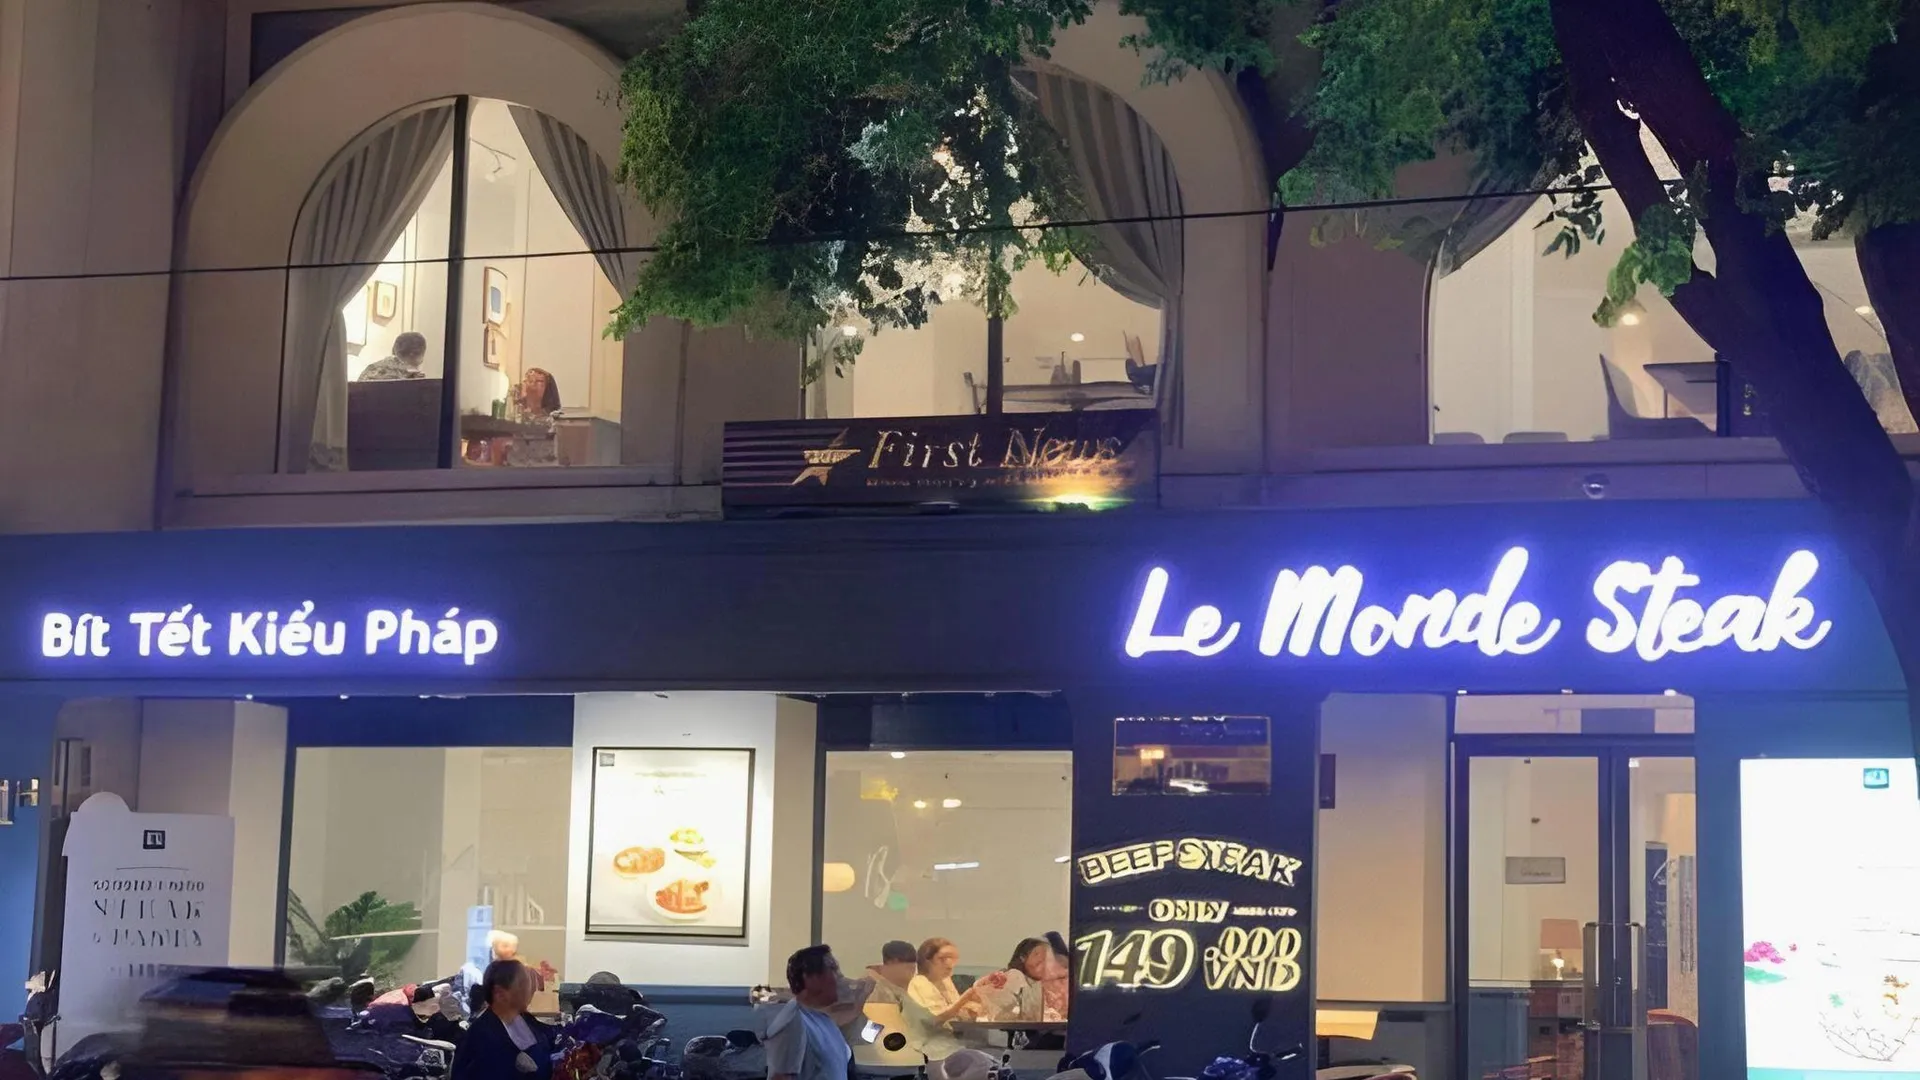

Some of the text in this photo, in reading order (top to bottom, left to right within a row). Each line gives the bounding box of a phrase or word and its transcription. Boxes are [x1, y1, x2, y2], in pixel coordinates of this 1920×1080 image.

[867, 430, 983, 469] First
[1125, 546, 1832, 661] Le Monde Steak
[42, 600, 498, 665] Bít Tết Kiểu Pháp
[1149, 899, 1230, 923] ONLY
